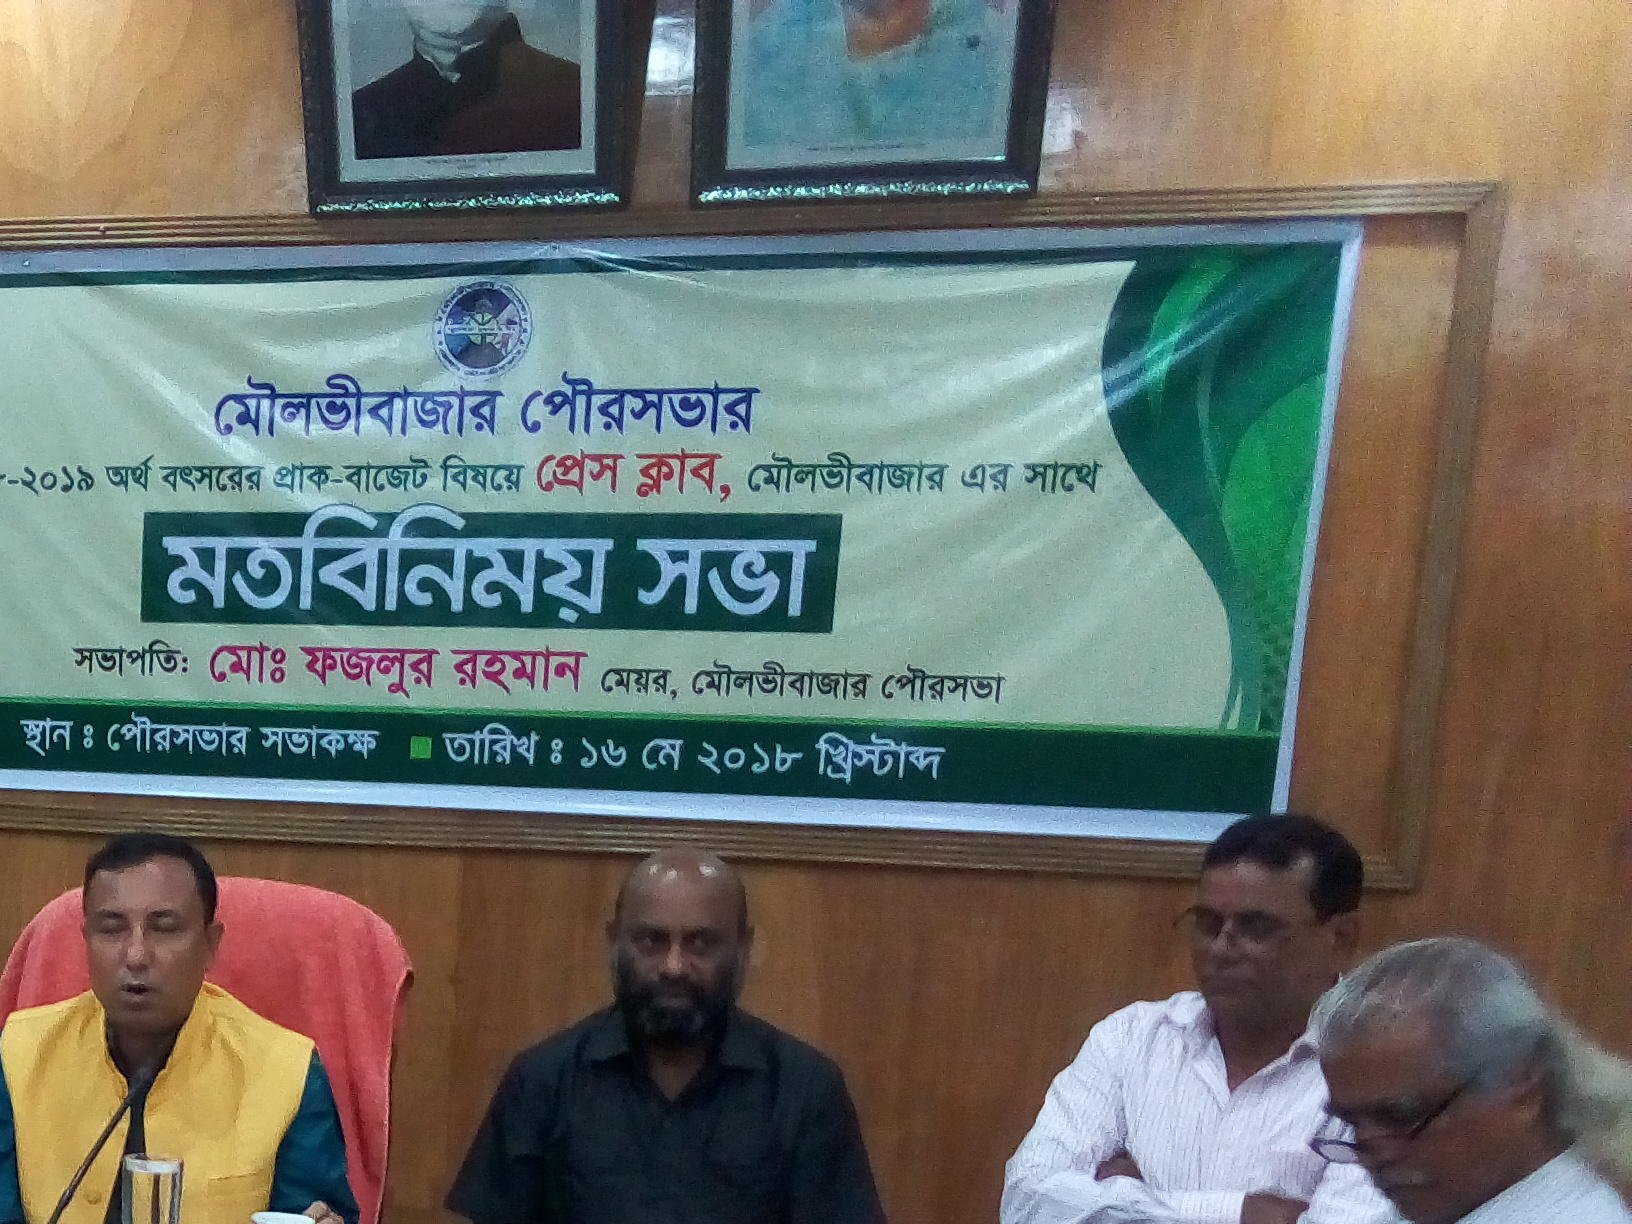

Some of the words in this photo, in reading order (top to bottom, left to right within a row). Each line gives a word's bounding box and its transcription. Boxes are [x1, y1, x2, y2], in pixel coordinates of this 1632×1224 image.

[214, 373, 504, 437] মৌলভীবাজার
[520, 371, 760, 436] পৌরসভার
[104, 454, 155, 494] অর্থ
[159, 464, 265, 494] বৎসরের
[273, 455, 432, 494] প্রাক-বাজেট
[441, 454, 525, 494] বিষয়ে
[536, 448, 625, 496] প্রেস
[635, 447, 732, 503] ক্লাব,
[747, 451, 950, 495] মৌলভীবাজার
[961, 461, 1014, 494] এর
[1023, 460, 1103, 495] সাথে
[162, 502, 614, 623] মতবিনিময়
[635, 539, 818, 617] সভা
[209, 641, 287, 685] মোঃ
[299, 645, 440, 699] ফজলুর
[451, 645, 589, 696] রহমান
[601, 668, 678, 700] মেয়র,
[692, 660, 872, 701] মৌলভীবাজার
[881, 664, 1006, 704] পৌরসভা
[20, 717, 73, 757] স্থান
[106, 711, 251, 756] পৌরসভার
[259, 725, 380, 760] সভাকক্ষ
[442, 722, 540, 766] তারিখ
[579, 737, 627, 769] ১৬
[642, 737, 684, 771] মে
[697, 741, 804, 775] ২০১৮
[815, 731, 947, 784] খ্রিস্টাব্দ
